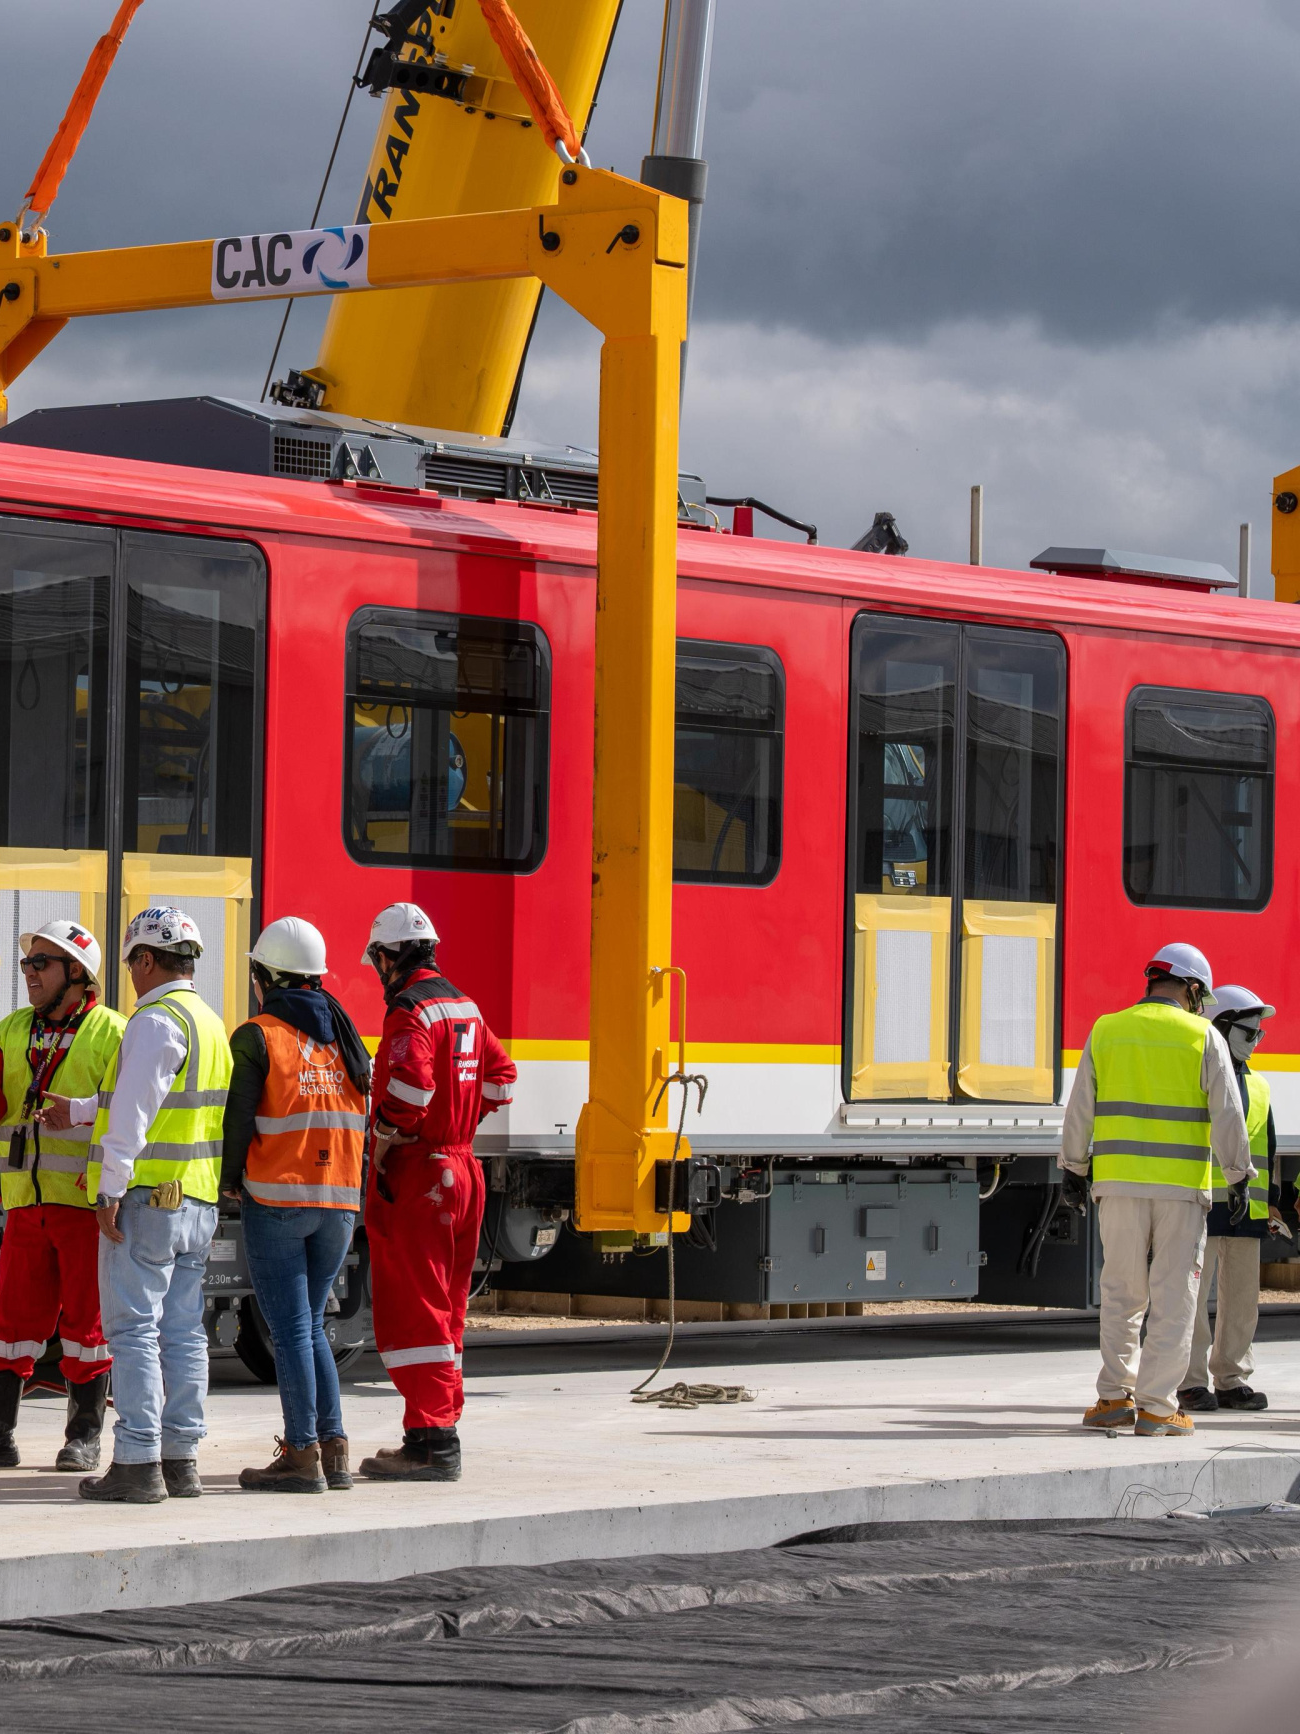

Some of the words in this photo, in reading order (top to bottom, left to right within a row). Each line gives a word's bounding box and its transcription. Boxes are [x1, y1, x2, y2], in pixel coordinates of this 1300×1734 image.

[216, 233, 293, 289] CAC
[146, 923, 158, 931] 3M
[299, 1070, 346, 1084] METRO
[209, 1274, 232, 1285] 2.30m
[329, 1328, 336, 1342] 5
